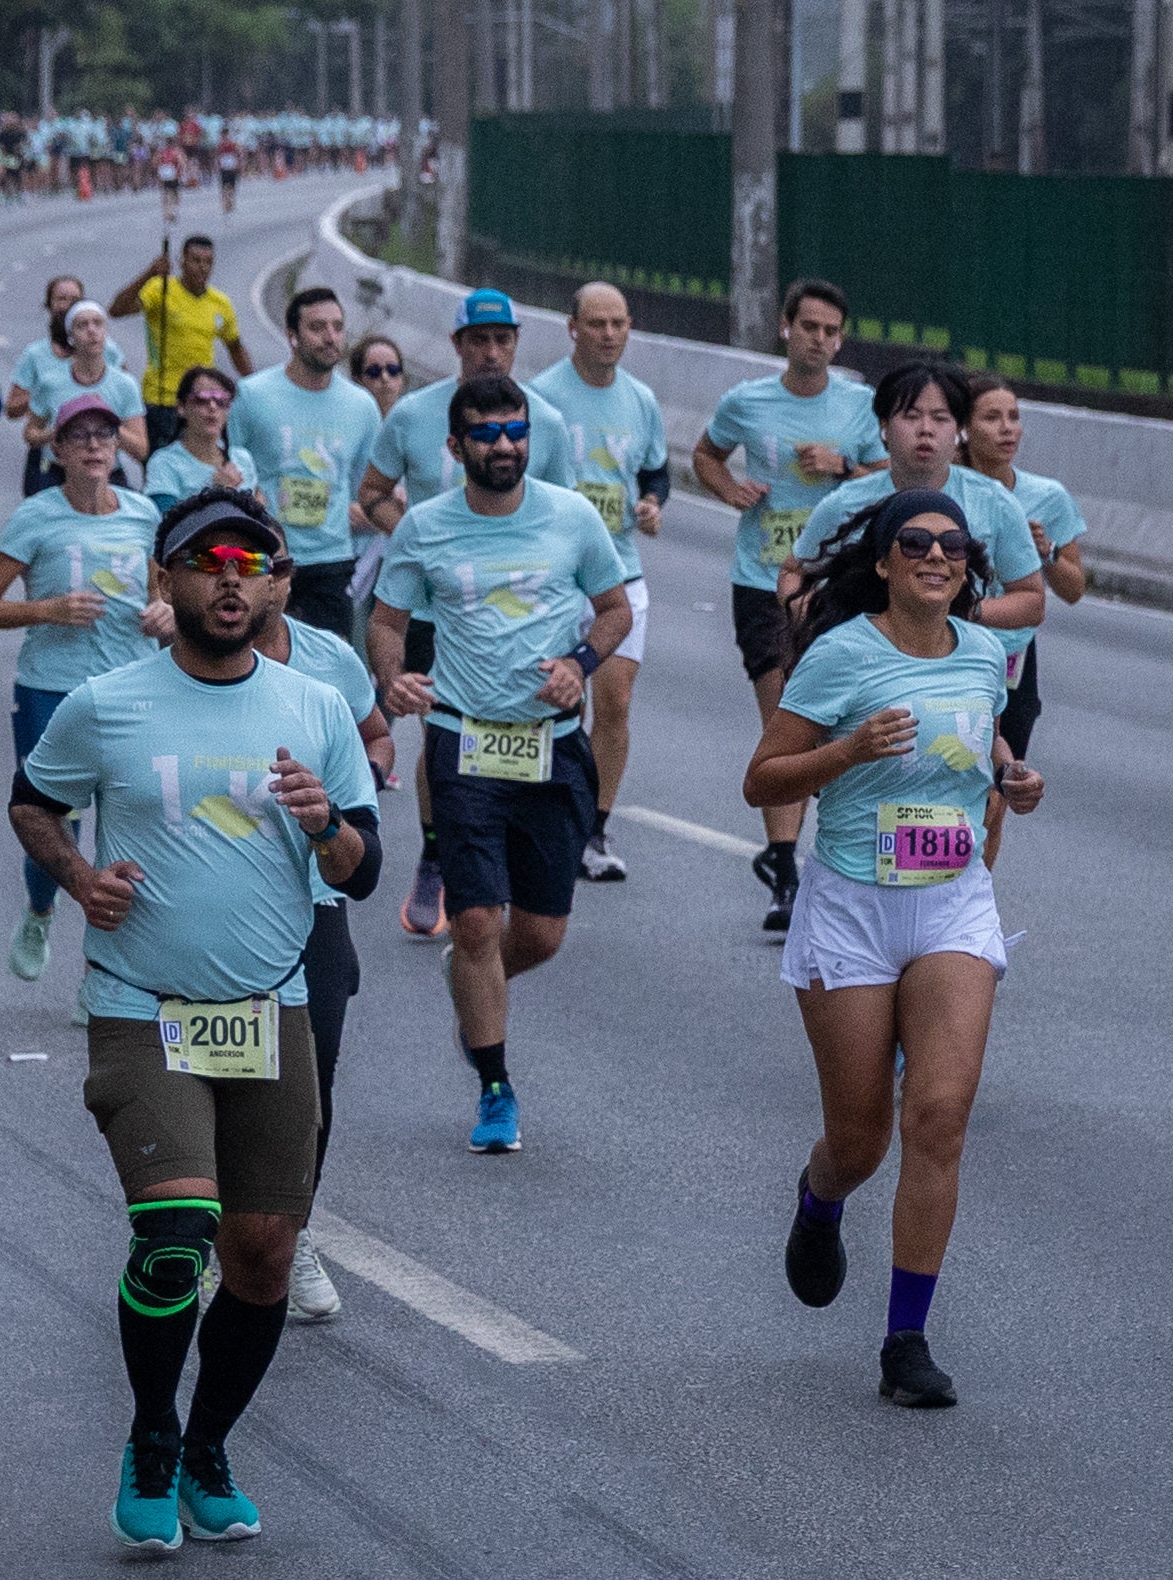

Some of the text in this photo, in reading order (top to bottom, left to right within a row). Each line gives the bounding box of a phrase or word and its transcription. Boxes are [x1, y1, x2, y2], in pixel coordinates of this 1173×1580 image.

[482, 733, 540, 759] 2025
[897, 807, 934, 819] SP10K
[905, 829, 971, 857] 1818
[190, 1015, 260, 1047] 2001
[209, 1050, 245, 1058] ANDERSON
